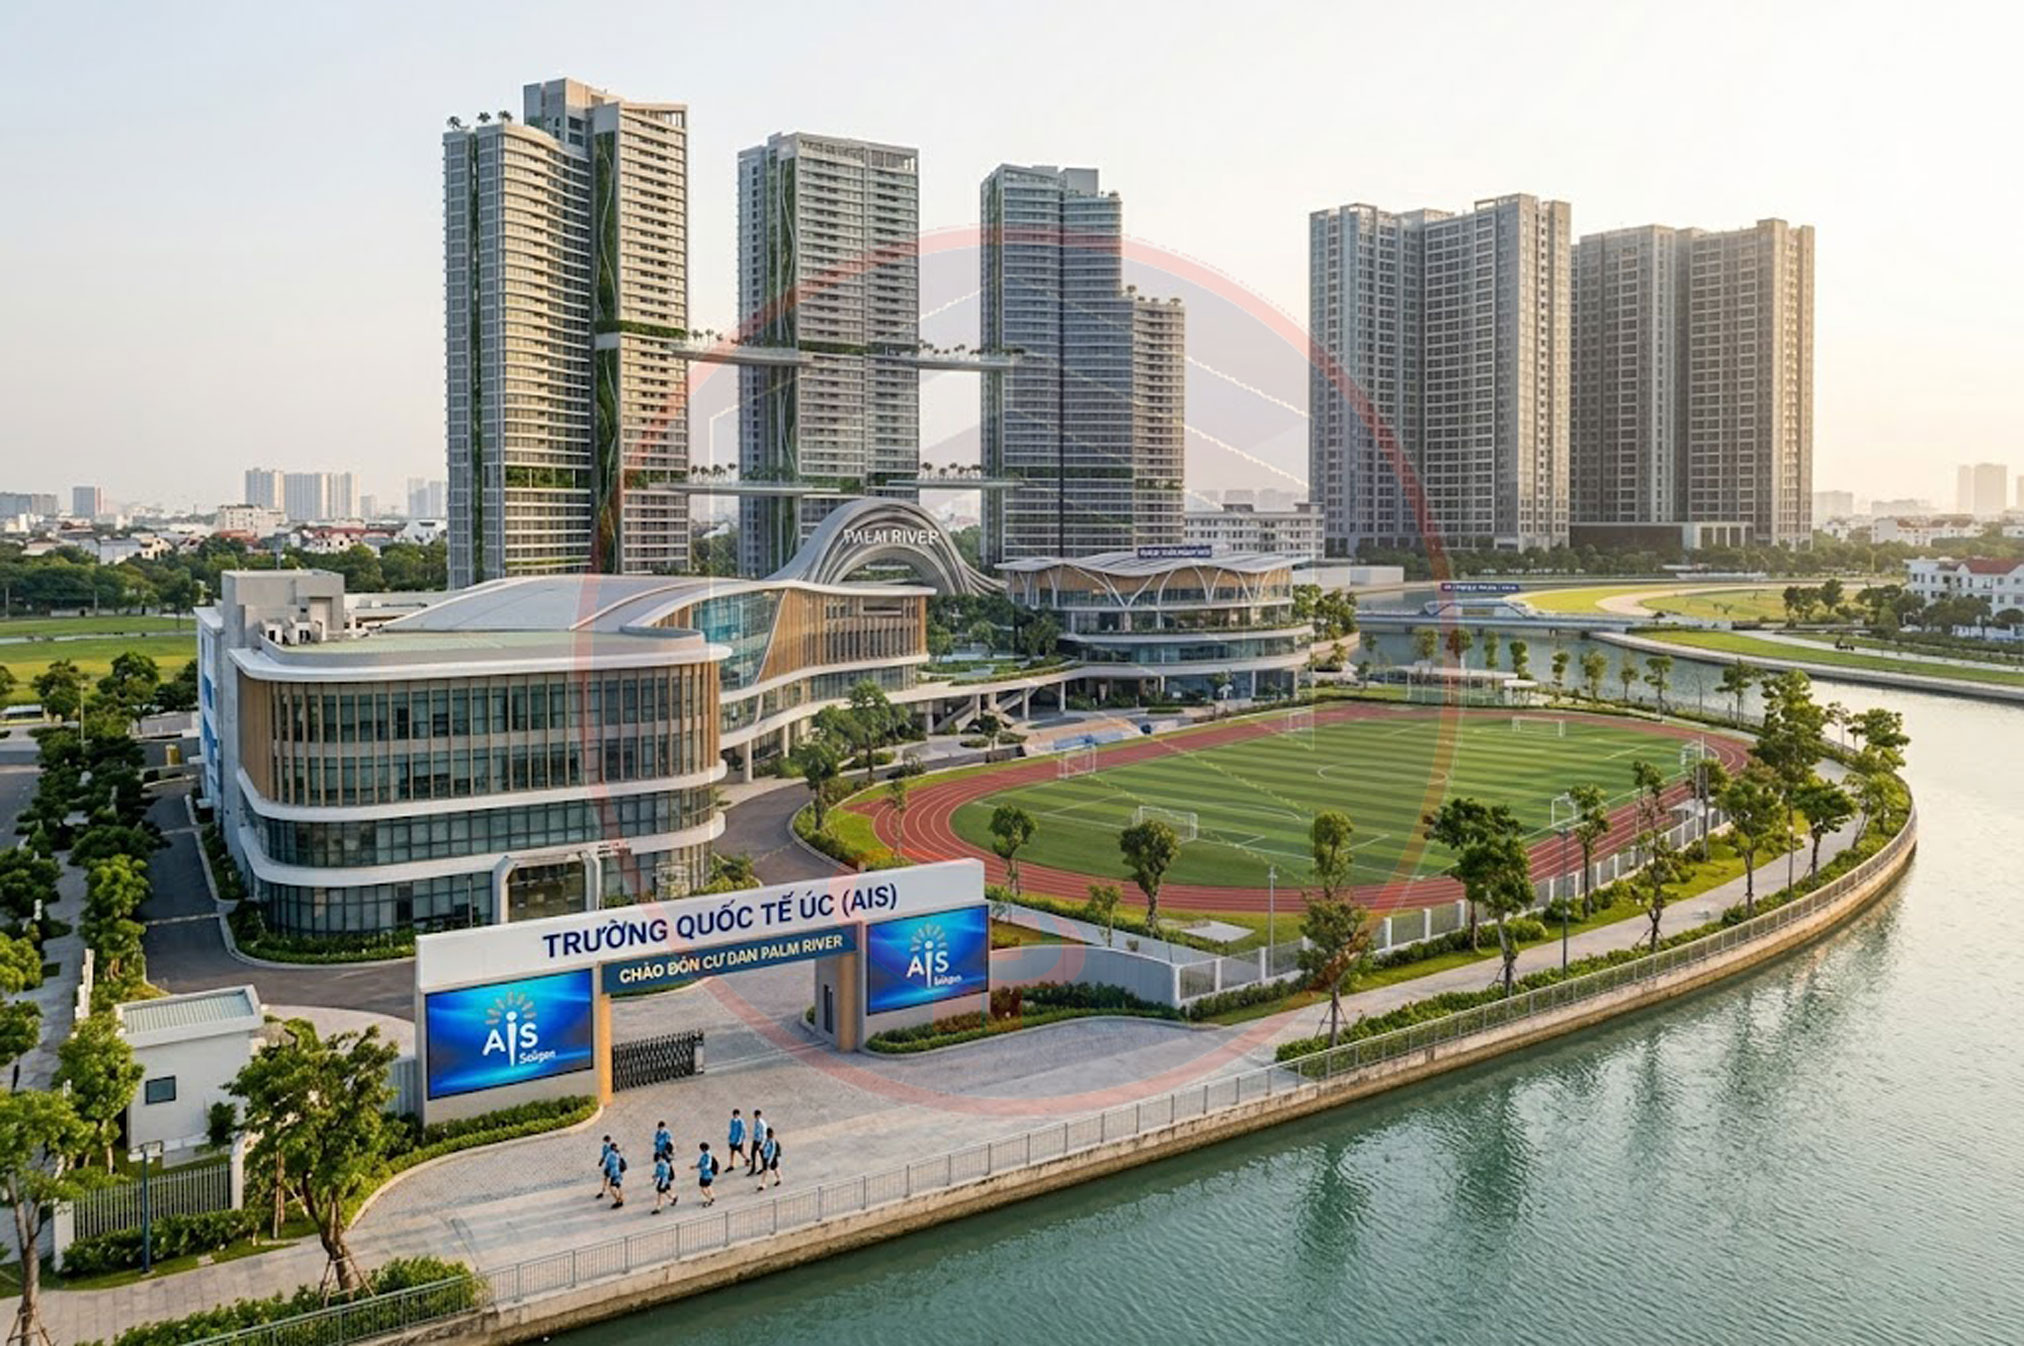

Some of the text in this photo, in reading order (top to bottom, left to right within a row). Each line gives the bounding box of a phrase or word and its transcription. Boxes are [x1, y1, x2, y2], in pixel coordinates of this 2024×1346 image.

[543, 883, 897, 958] TRƯỜNG QUỐC TẾ ÚC (AIS)
[702, 952, 725, 969] CƯ
[760, 942, 800, 960] PALM
[802, 934, 843, 953] RIVER
